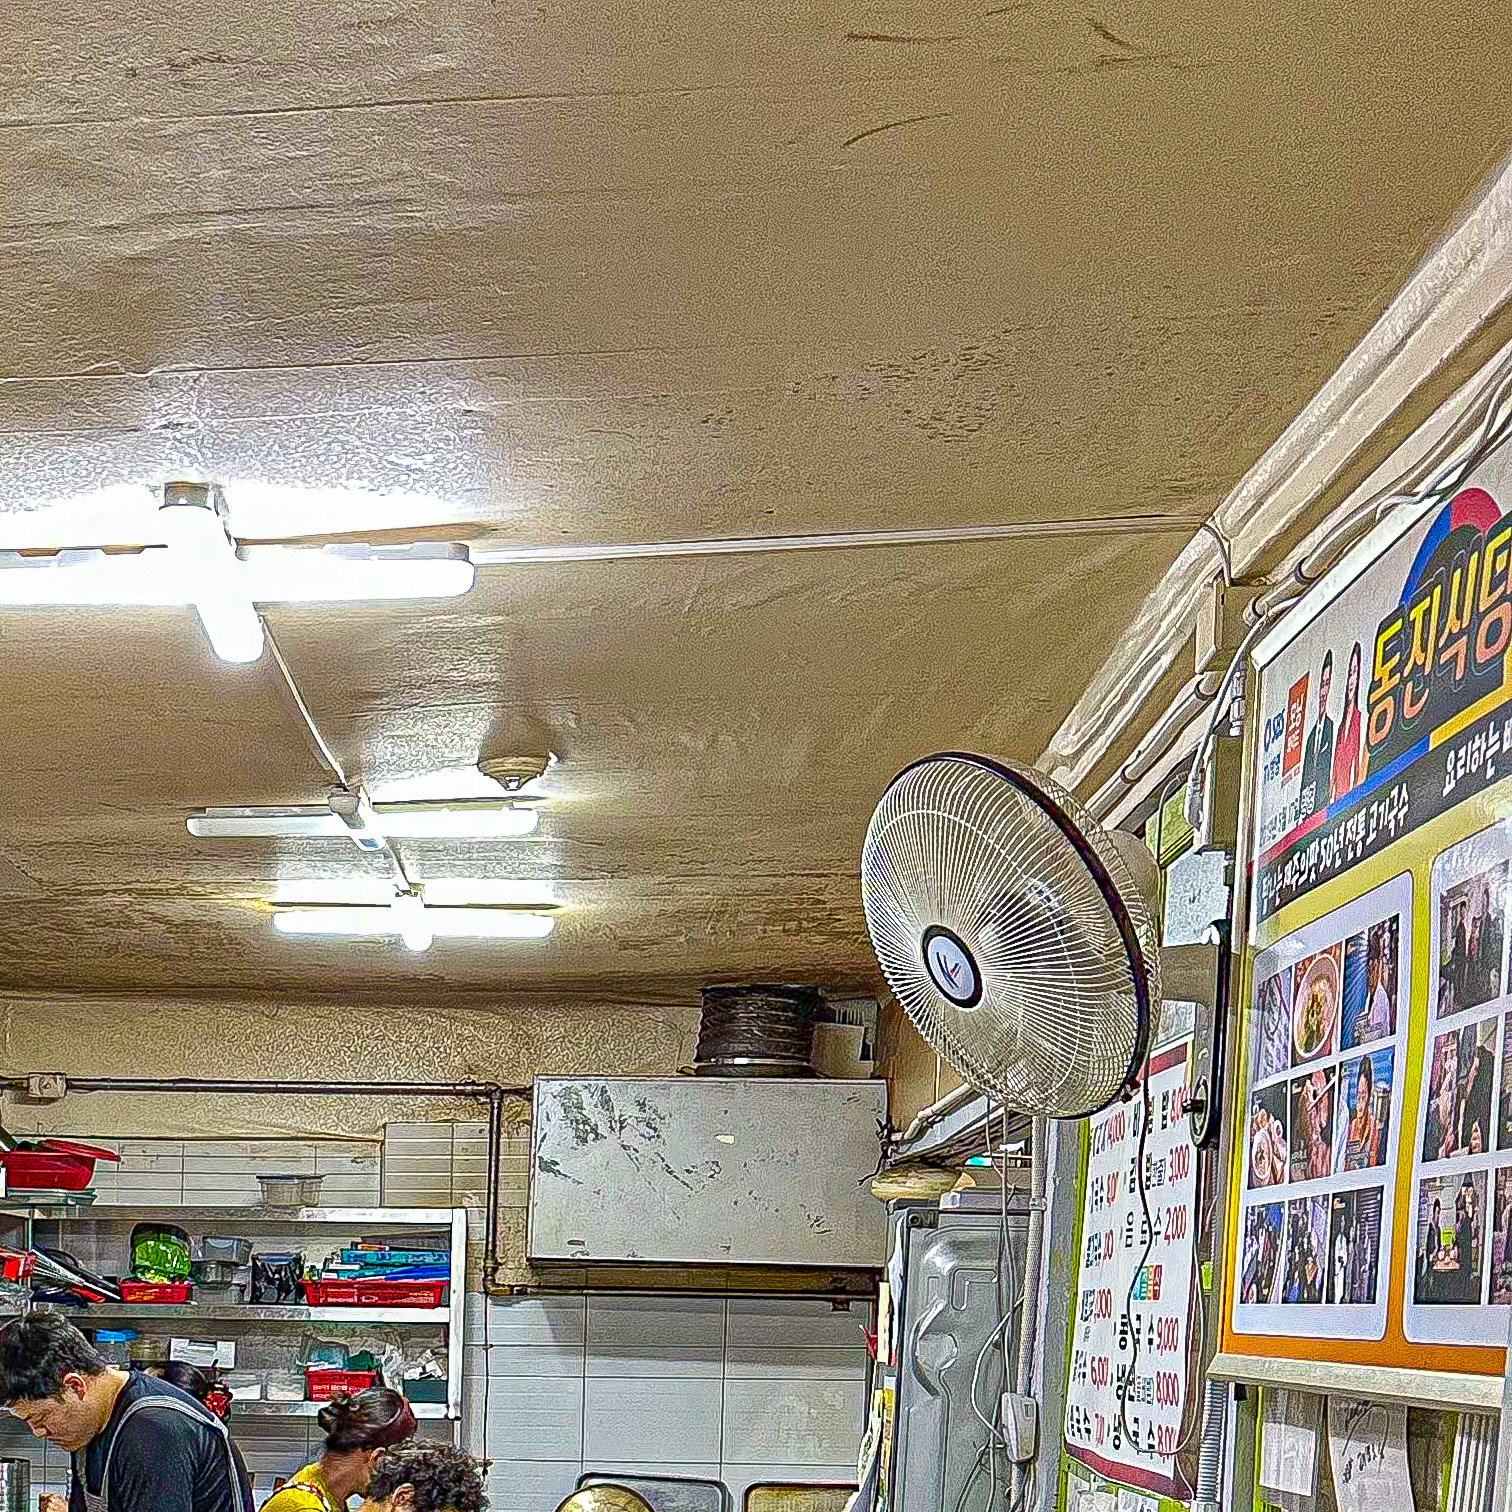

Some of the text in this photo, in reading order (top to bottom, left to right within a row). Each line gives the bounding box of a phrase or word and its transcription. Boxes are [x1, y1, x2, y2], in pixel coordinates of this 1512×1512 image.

[1442, 721, 1501, 797] 요리하는
[1366, 782, 1409, 847] 고기국수
[1169, 1143, 1190, 1188] 3,000
[1164, 1204, 1187, 1247] 2,000
[1157, 1317, 1180, 1357] 9,000
[1156, 1370, 1180, 1411] 8,000
